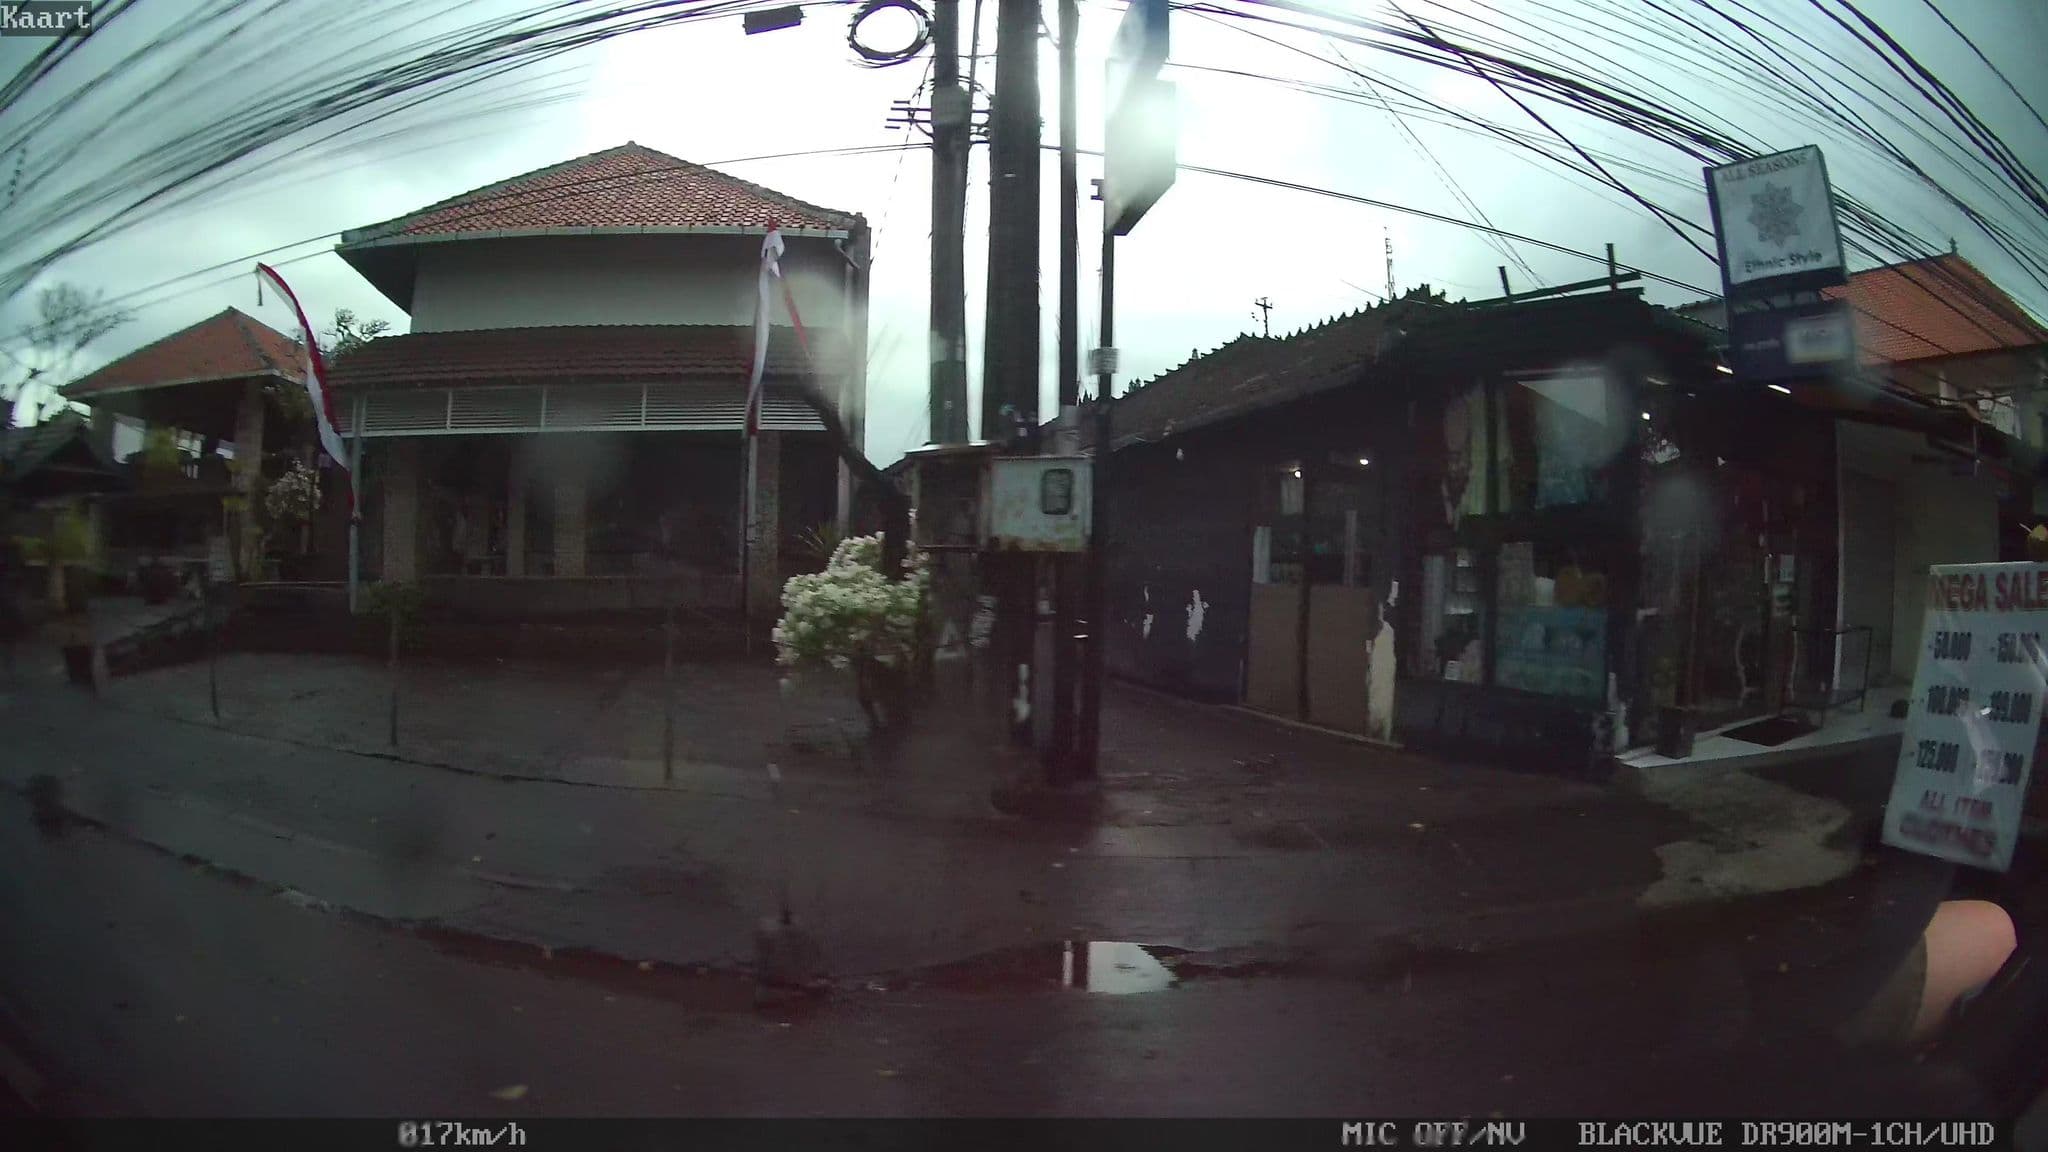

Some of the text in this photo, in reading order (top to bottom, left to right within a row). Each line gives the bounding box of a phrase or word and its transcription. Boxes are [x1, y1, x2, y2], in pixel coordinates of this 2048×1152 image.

[1745, 250, 1823, 274] Ethnic Style
[1995, 570, 2048, 612] SALE
